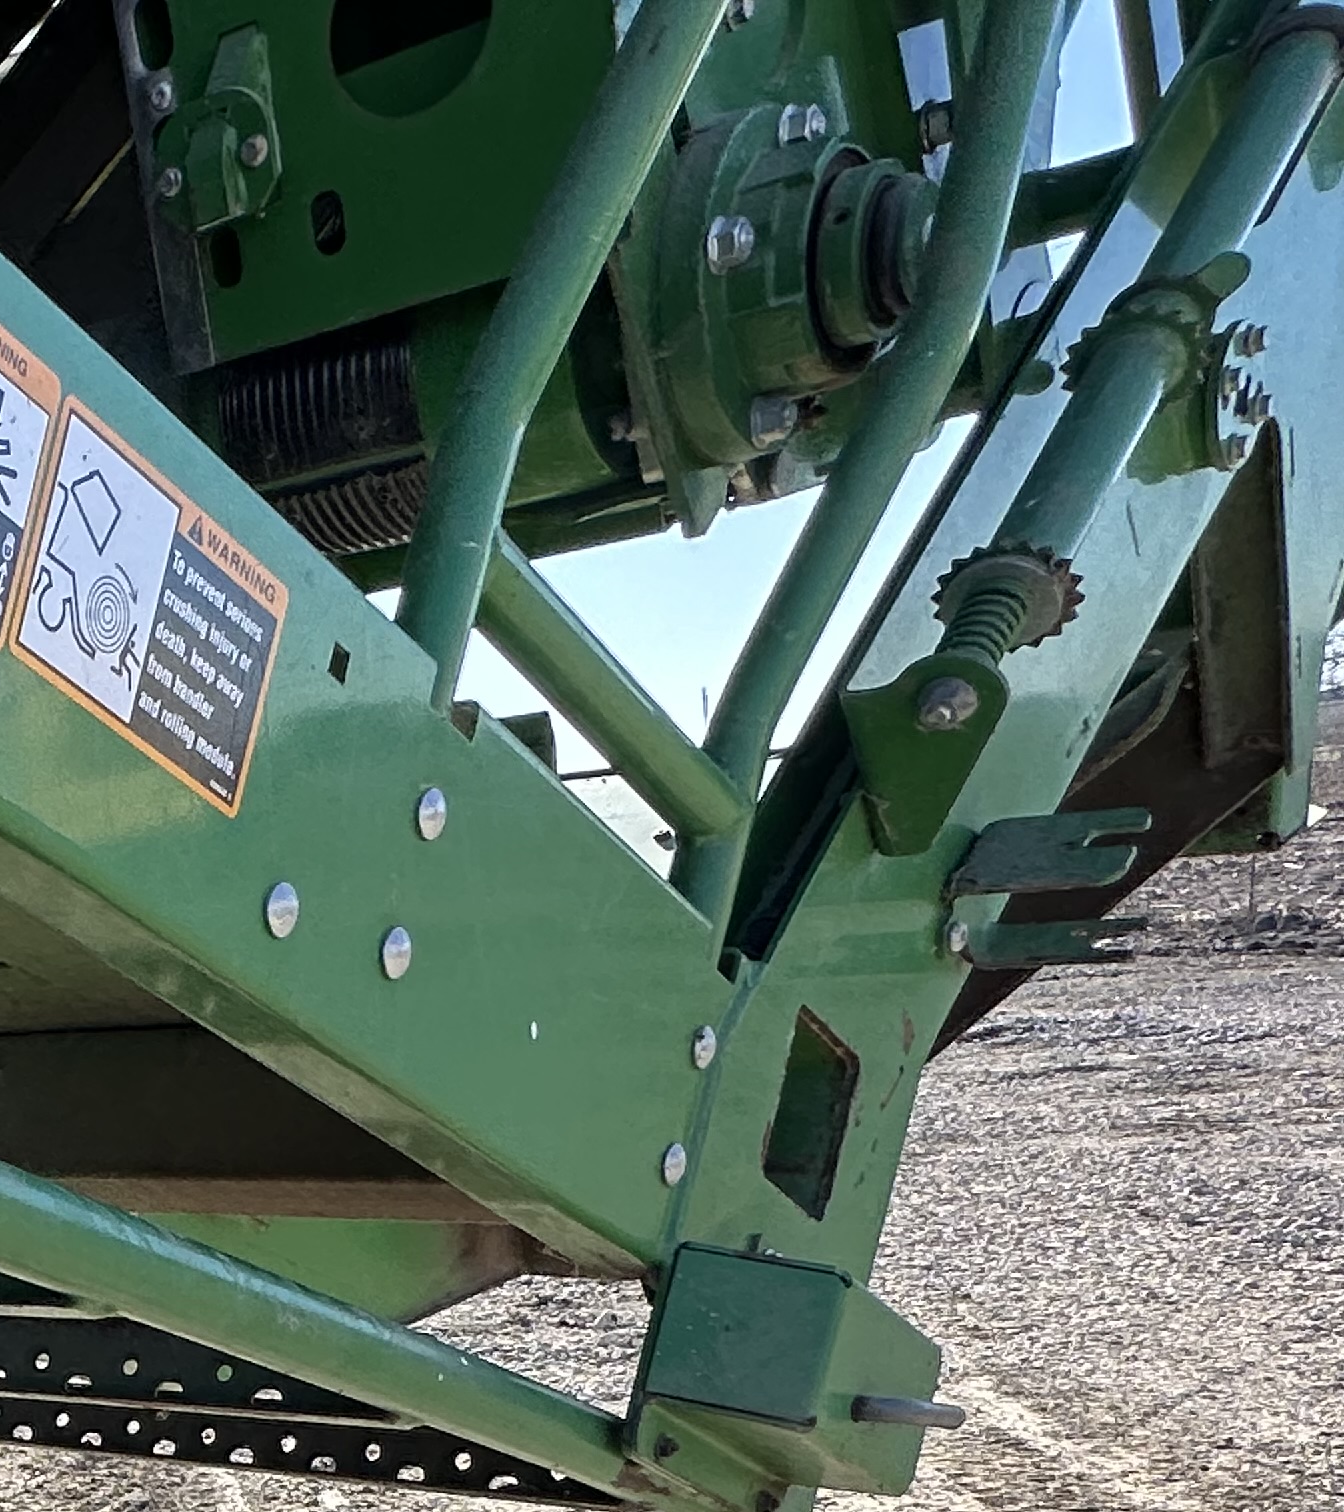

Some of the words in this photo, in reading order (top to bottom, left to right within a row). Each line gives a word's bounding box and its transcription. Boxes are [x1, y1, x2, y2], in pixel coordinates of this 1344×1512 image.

[170, 548, 187, 577] To
[183, 563, 227, 613] prevent
[224, 596, 264, 645] serious
[207, 531, 277, 606] WARNING
[153, 616, 191, 665] death,
[188, 645, 217, 687] keep
[214, 670, 245, 711] away
[161, 584, 210, 642] crushing
[207, 621, 240, 667] injury
[137, 685, 161, 720] and
[159, 701, 196, 753] rolling
[145, 650, 175, 690] from
[171, 672, 215, 723] handler
